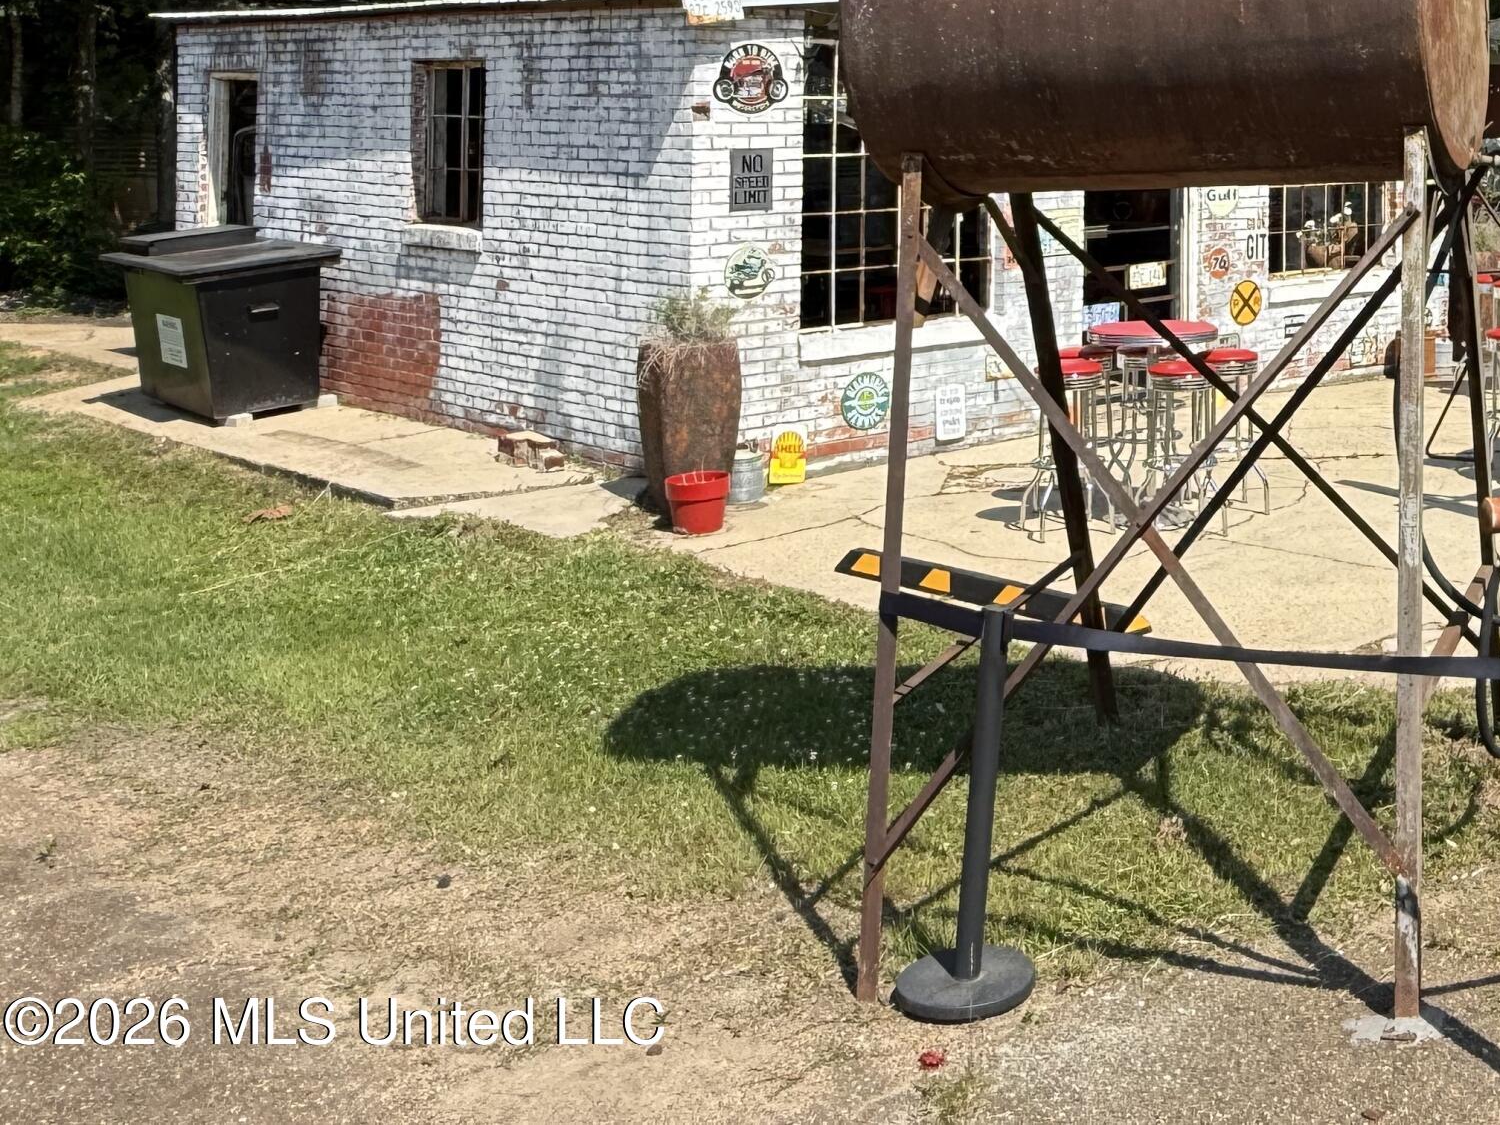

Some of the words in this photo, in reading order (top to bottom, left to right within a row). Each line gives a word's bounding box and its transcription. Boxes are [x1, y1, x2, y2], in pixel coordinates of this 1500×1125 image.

[742, 154, 763, 173] NO
[734, 175, 769, 189] SPEED
[734, 189, 769, 205] LIMIT
[1212, 255, 1228, 270] 76
